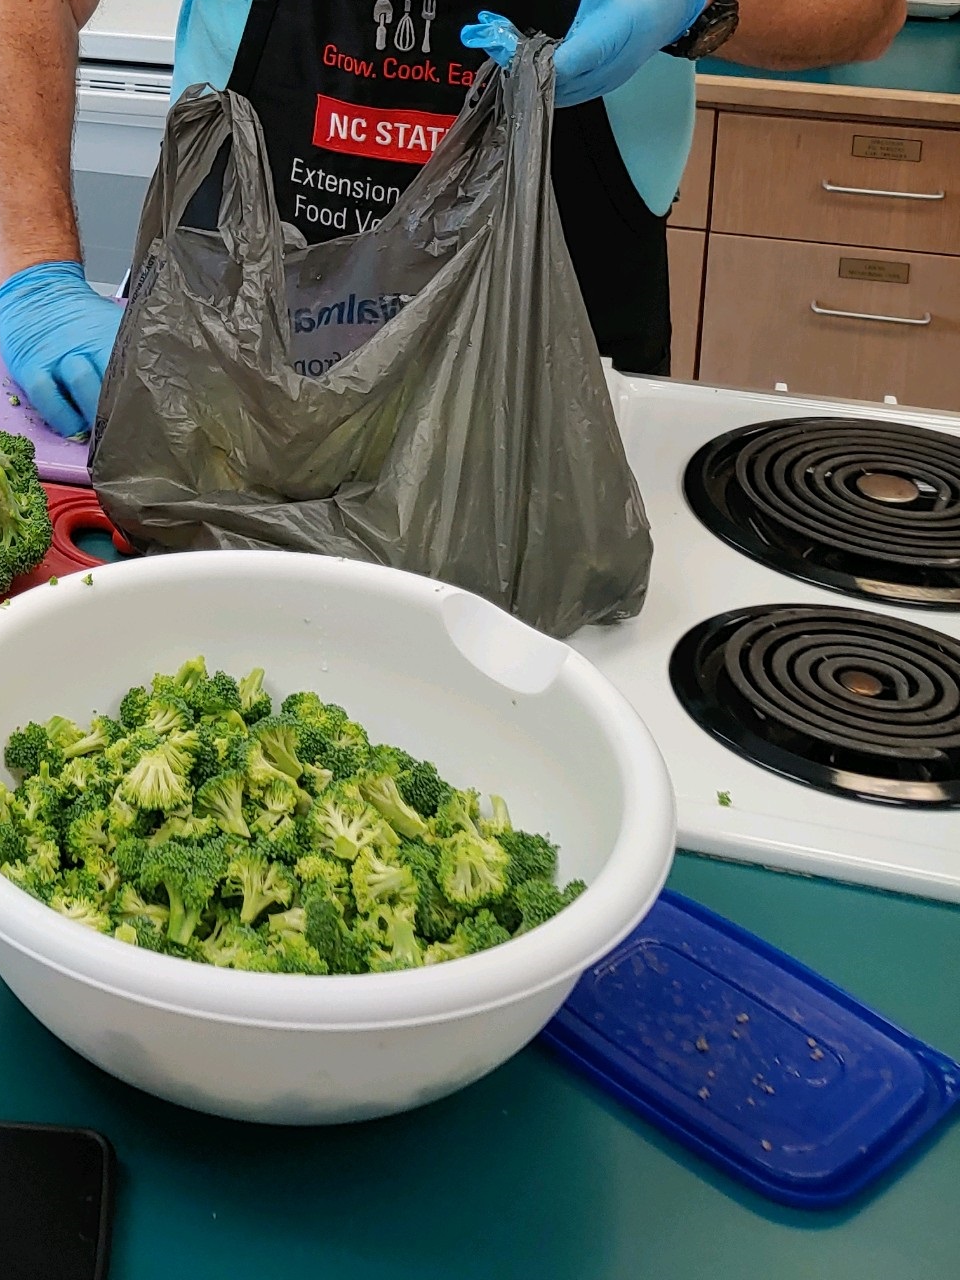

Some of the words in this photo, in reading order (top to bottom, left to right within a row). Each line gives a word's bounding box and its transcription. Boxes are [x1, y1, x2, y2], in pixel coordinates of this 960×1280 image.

[323, 44, 377, 78] Grow.
[383, 58, 440, 83] Cook.
[448, 63, 486, 88] Ea.
[328, 113, 367, 142] NC
[375, 121, 449, 152] STAT
[291, 157, 400, 204] Extension
[295, 194, 347, 230] Food
